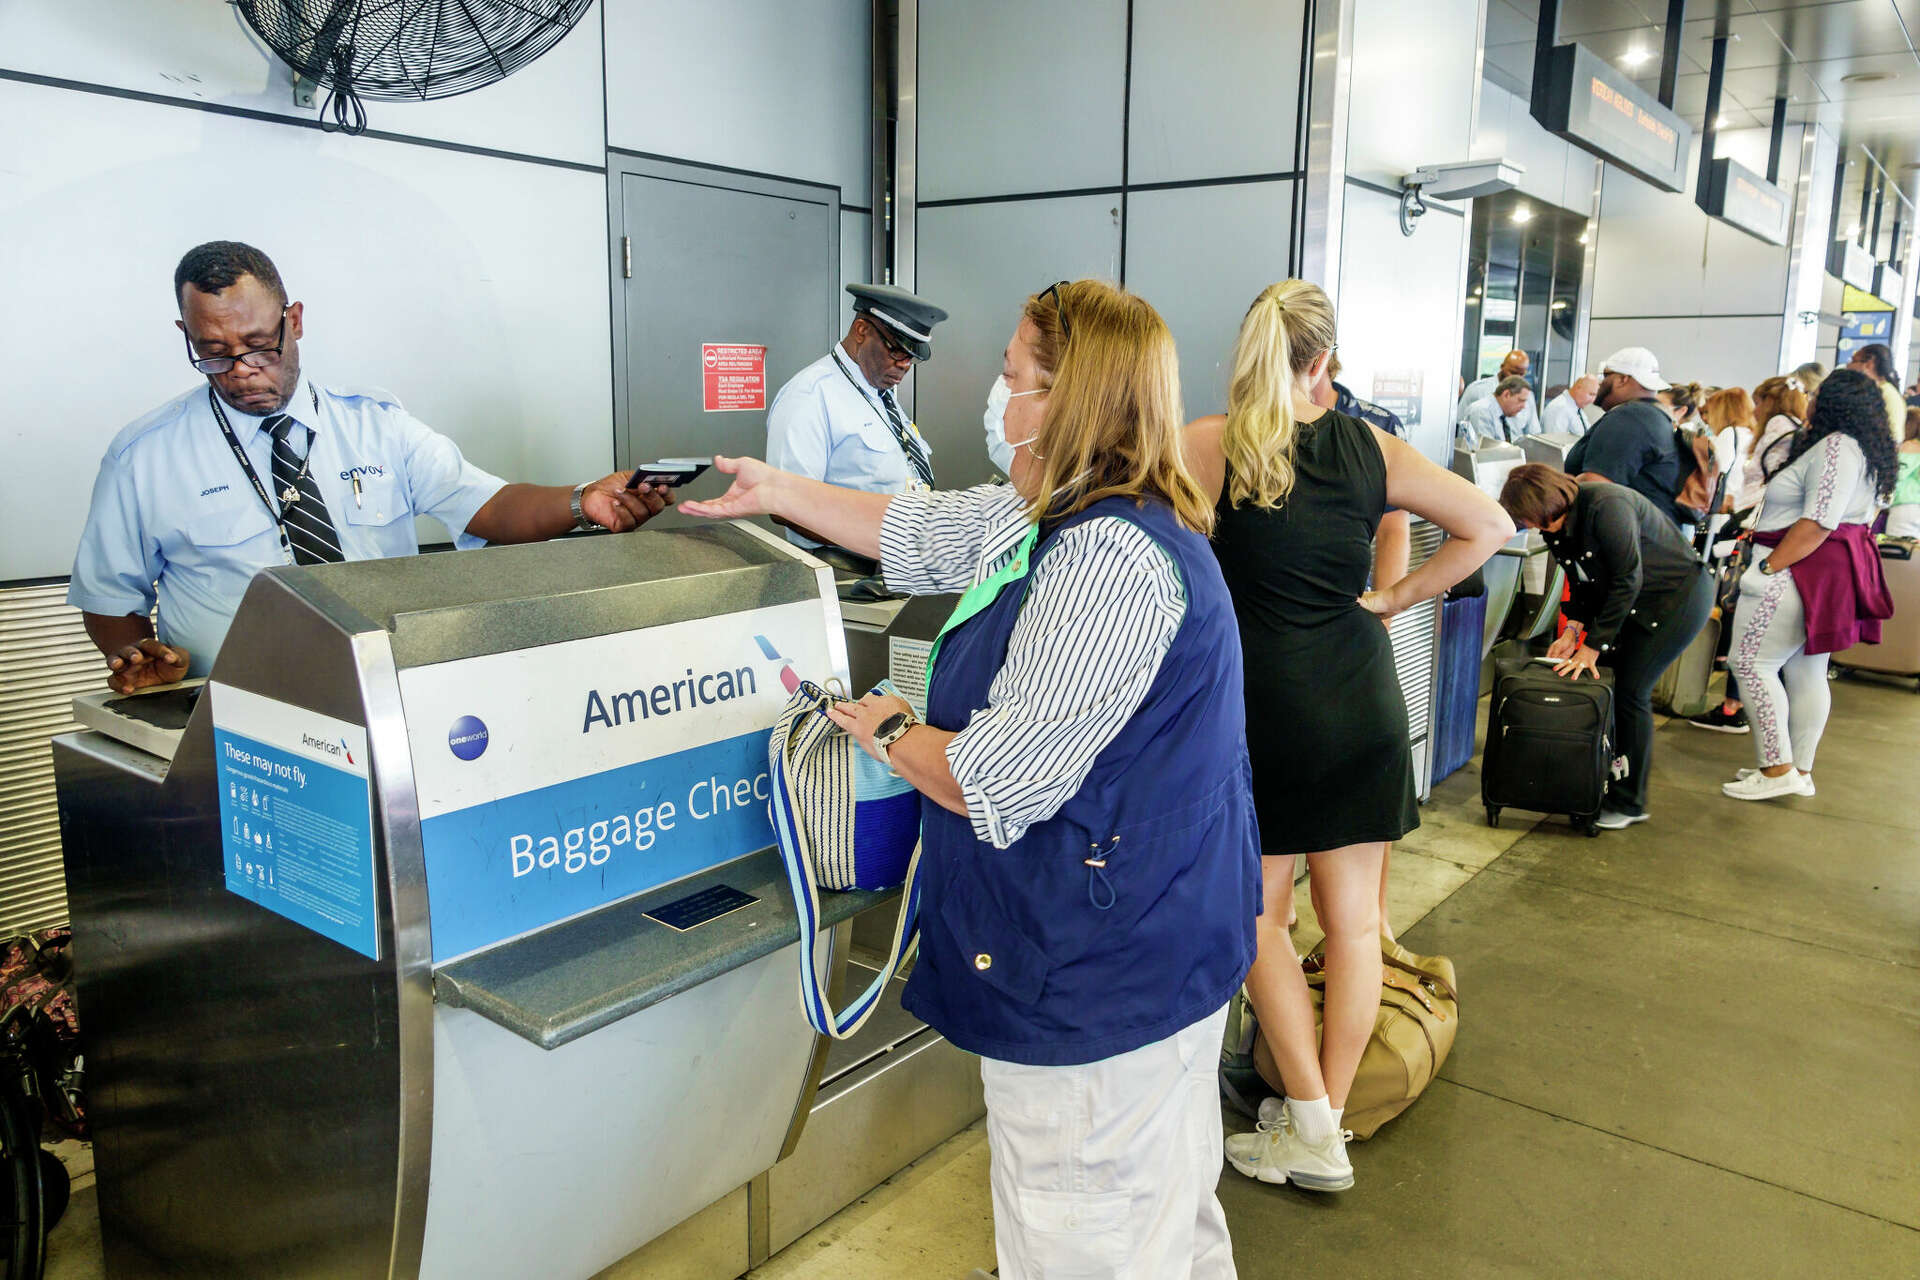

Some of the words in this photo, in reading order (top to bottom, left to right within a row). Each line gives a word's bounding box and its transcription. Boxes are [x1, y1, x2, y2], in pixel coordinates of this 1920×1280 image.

[340, 465, 384, 481] envoy
[200, 485, 230, 496] JOSEPH
[582, 666, 756, 734] American
[302, 732, 341, 757] American
[450, 730, 488, 746] oneworld
[224, 742, 251, 765] These
[253, 755, 273, 777] may
[274, 763, 292, 780] not
[293, 766, 308, 789] fly.
[510, 801, 676, 879] Baggage
[688, 772, 769, 820] Chec
